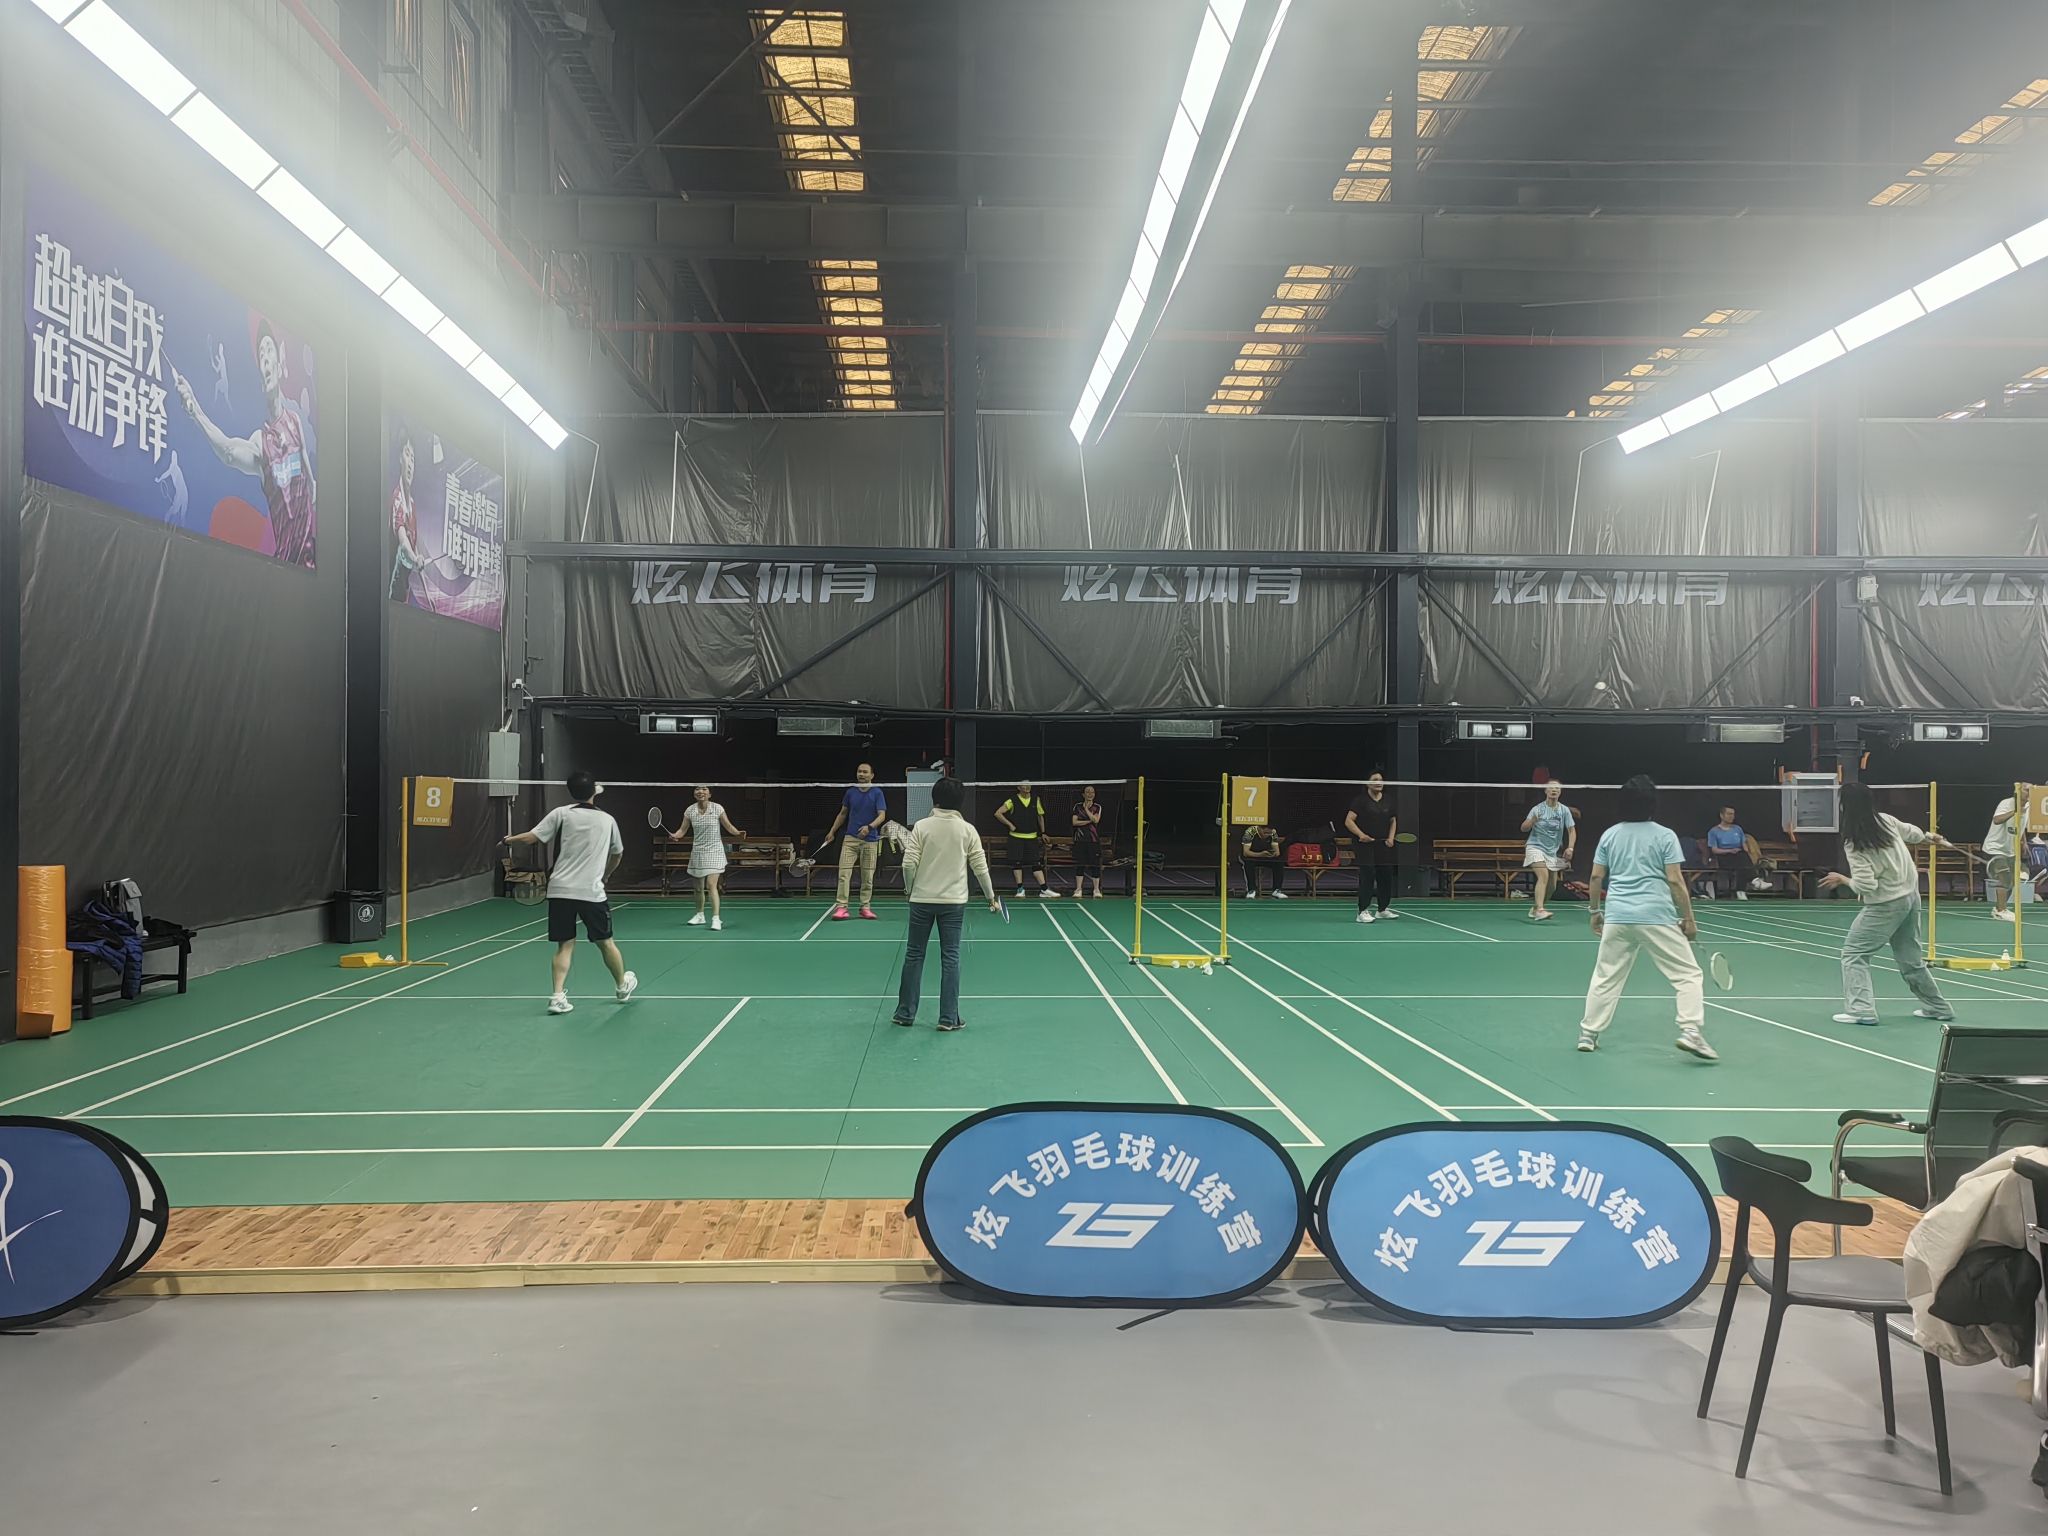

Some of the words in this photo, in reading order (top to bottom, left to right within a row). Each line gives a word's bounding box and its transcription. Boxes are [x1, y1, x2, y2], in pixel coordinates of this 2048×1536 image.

[33, 233, 164, 381] 超越自我
[33, 320, 167, 464] 谁羽争锋
[426, 786, 441, 808] 8
[1243, 786, 1258, 808] 7
[964, 1131, 1263, 1254] 炫飞羽毛球训练营
[1373, 1149, 1681, 1273] 炫飞羽毛球训练营
